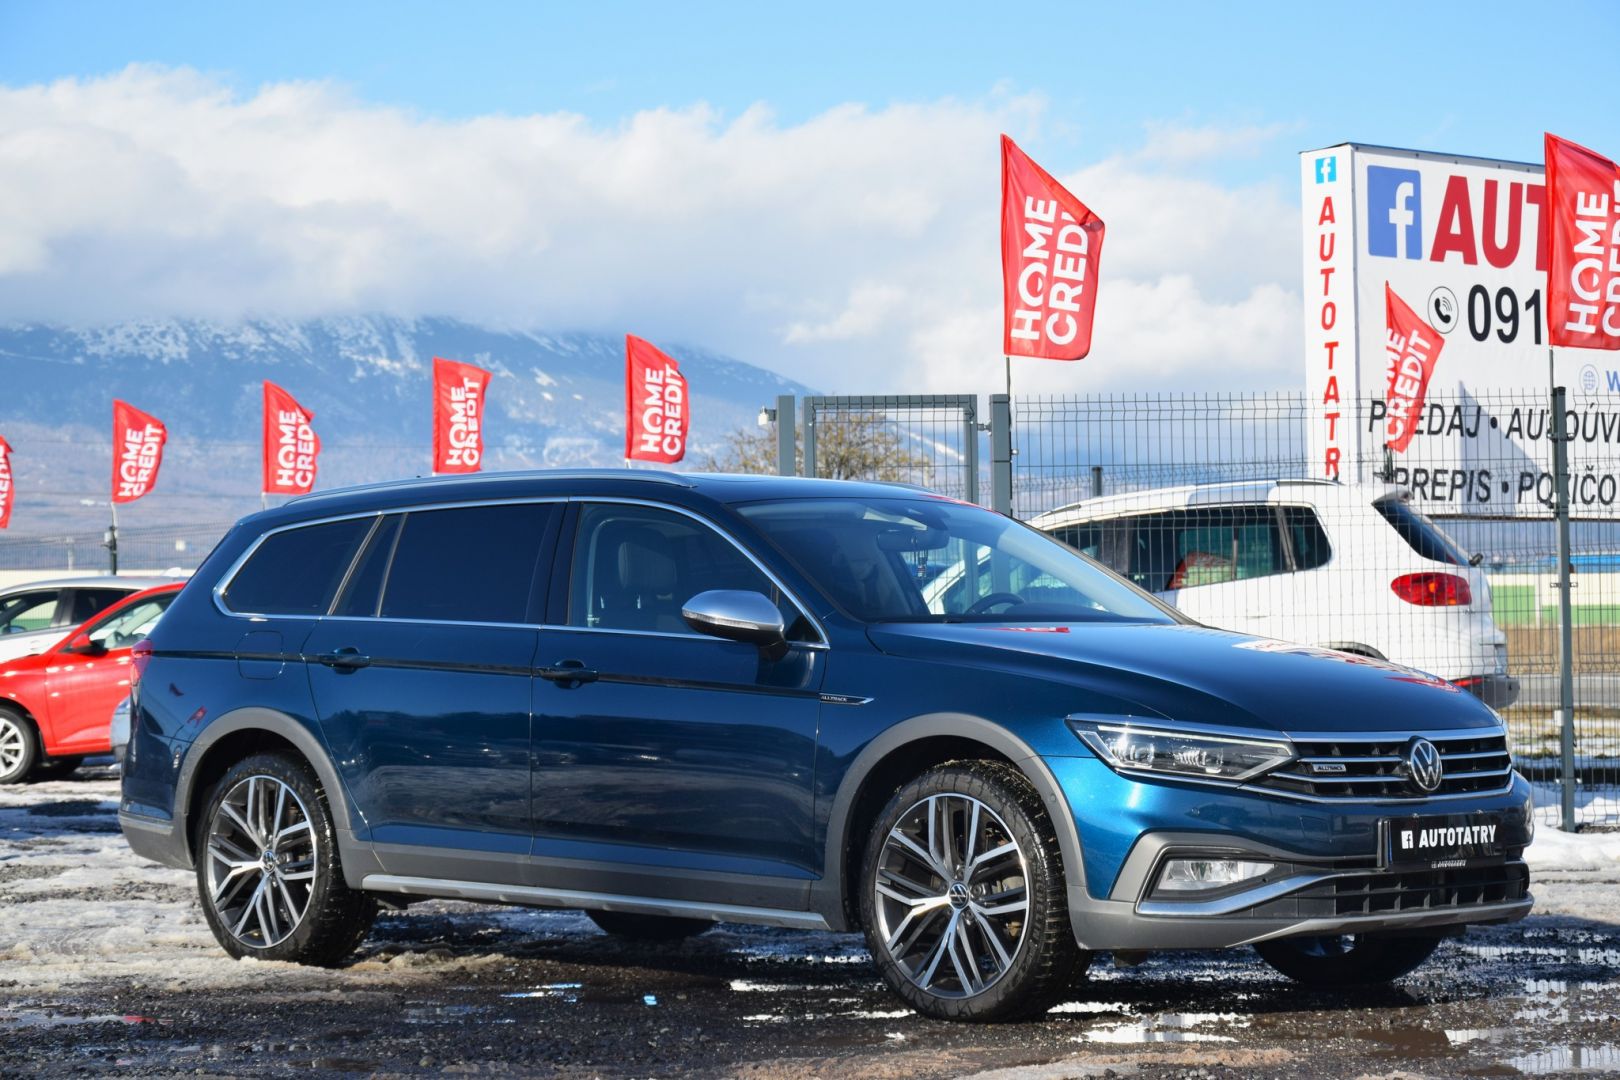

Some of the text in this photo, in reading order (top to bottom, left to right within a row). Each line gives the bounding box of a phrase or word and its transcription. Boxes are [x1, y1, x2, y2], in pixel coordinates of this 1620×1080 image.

[1010, 195, 1057, 341] HOME
[1045, 211, 1089, 346] CRED
[1565, 190, 1609, 335] HOME
[445, 385, 468, 466] HOME
[462, 376, 481, 466] CREDIT
[640, 367, 664, 454] HOME
[662, 363, 683, 456] CREDIT
[1369, 400, 1620, 443] PDAJ AUOÚV
[1385, 329, 1431, 444] CREDIT
[118, 427, 144, 497] HOME
[132, 423, 164, 496] CREDIT
[276, 410, 297, 486] HOME
[1394, 464, 1617, 505] PREPIS POIČO
[1418, 824, 1497, 848] AUTOTATRY
